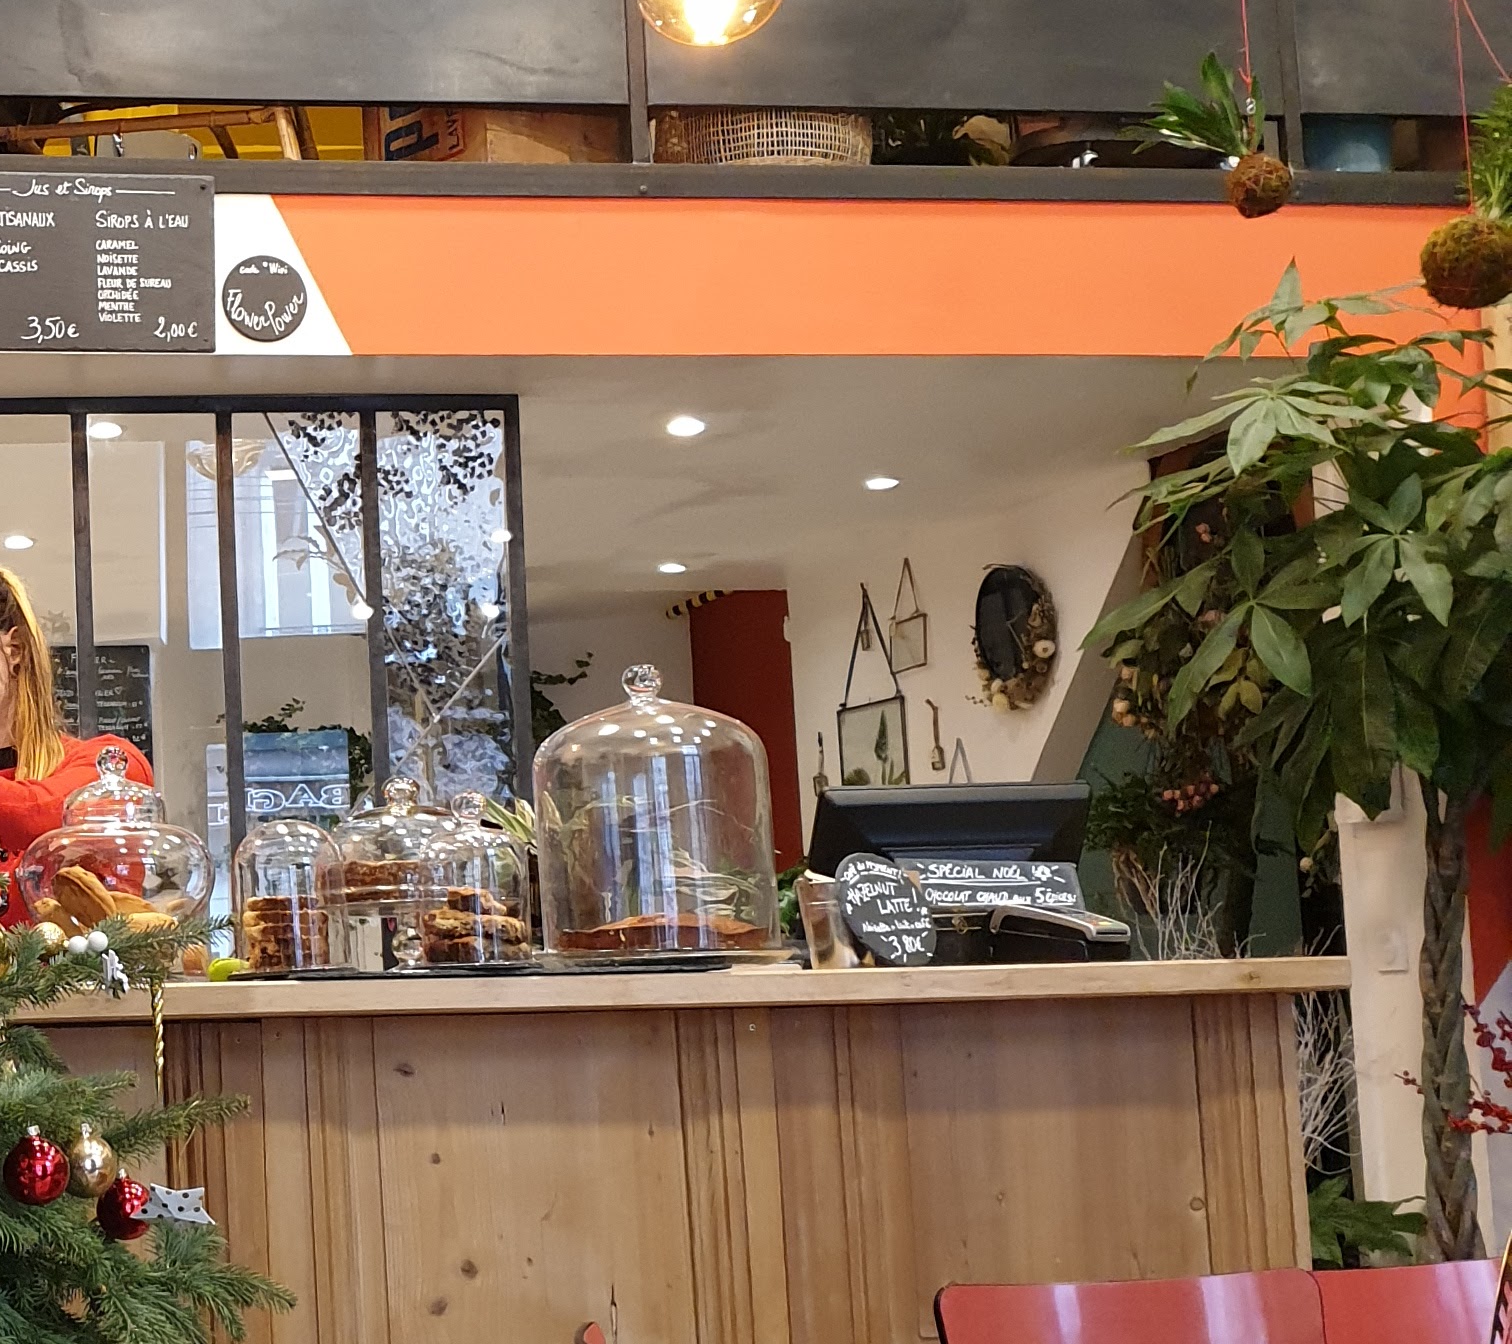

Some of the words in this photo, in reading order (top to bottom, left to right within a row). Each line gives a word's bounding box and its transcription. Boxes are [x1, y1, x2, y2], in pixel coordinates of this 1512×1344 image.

[12, 179, 50, 196] Jus
[55, 181, 72, 194] et
[73, 178, 112, 203] Sirops
[145, 209, 153, 228] À
[159, 213, 189, 228] L'EAU
[95, 240, 139, 250] CARAMEL
[97, 265, 138, 276] LAVANDE
[97, 278, 123, 289] FLEUR
[126, 278, 137, 288] DE
[140, 278, 172, 289] SUREAU
[98, 301, 135, 311] MENTHE
[1035, 887, 1045, 903] 5
